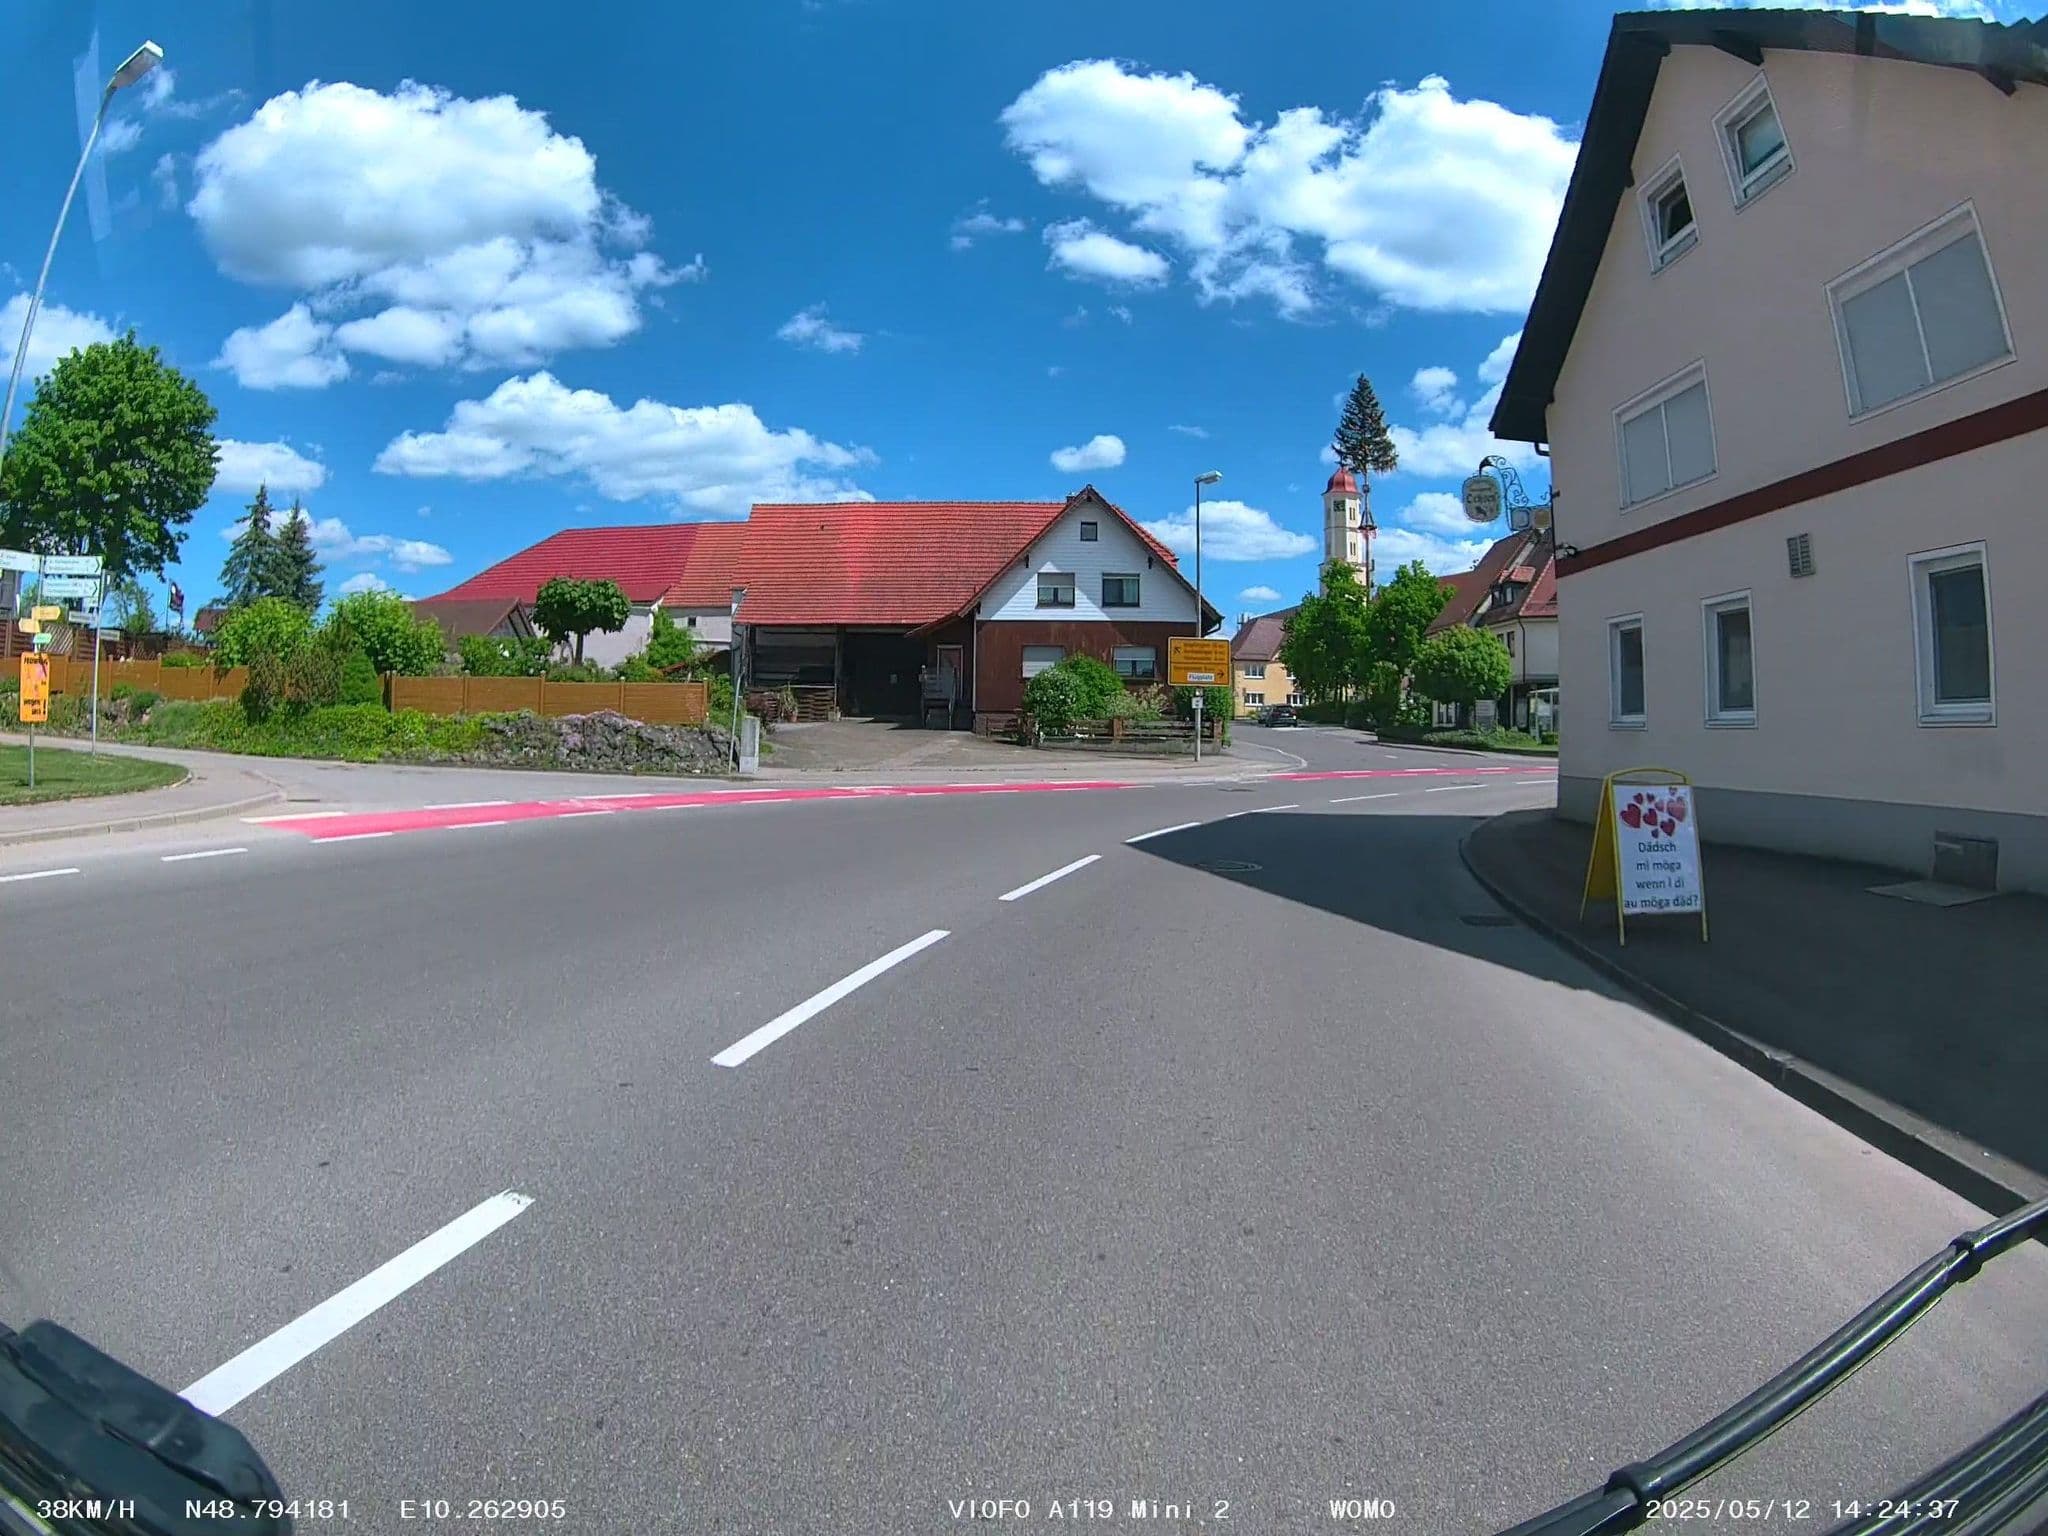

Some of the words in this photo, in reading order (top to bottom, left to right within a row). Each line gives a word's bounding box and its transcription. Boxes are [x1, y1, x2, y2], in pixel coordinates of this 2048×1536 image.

[1638, 841, 1676, 853] Dädsch
[1653, 860, 1681, 873] möga
[1635, 879, 1665, 889] wenn
[1624, 900, 1637, 908] au
[1641, 896, 1670, 909] möga
